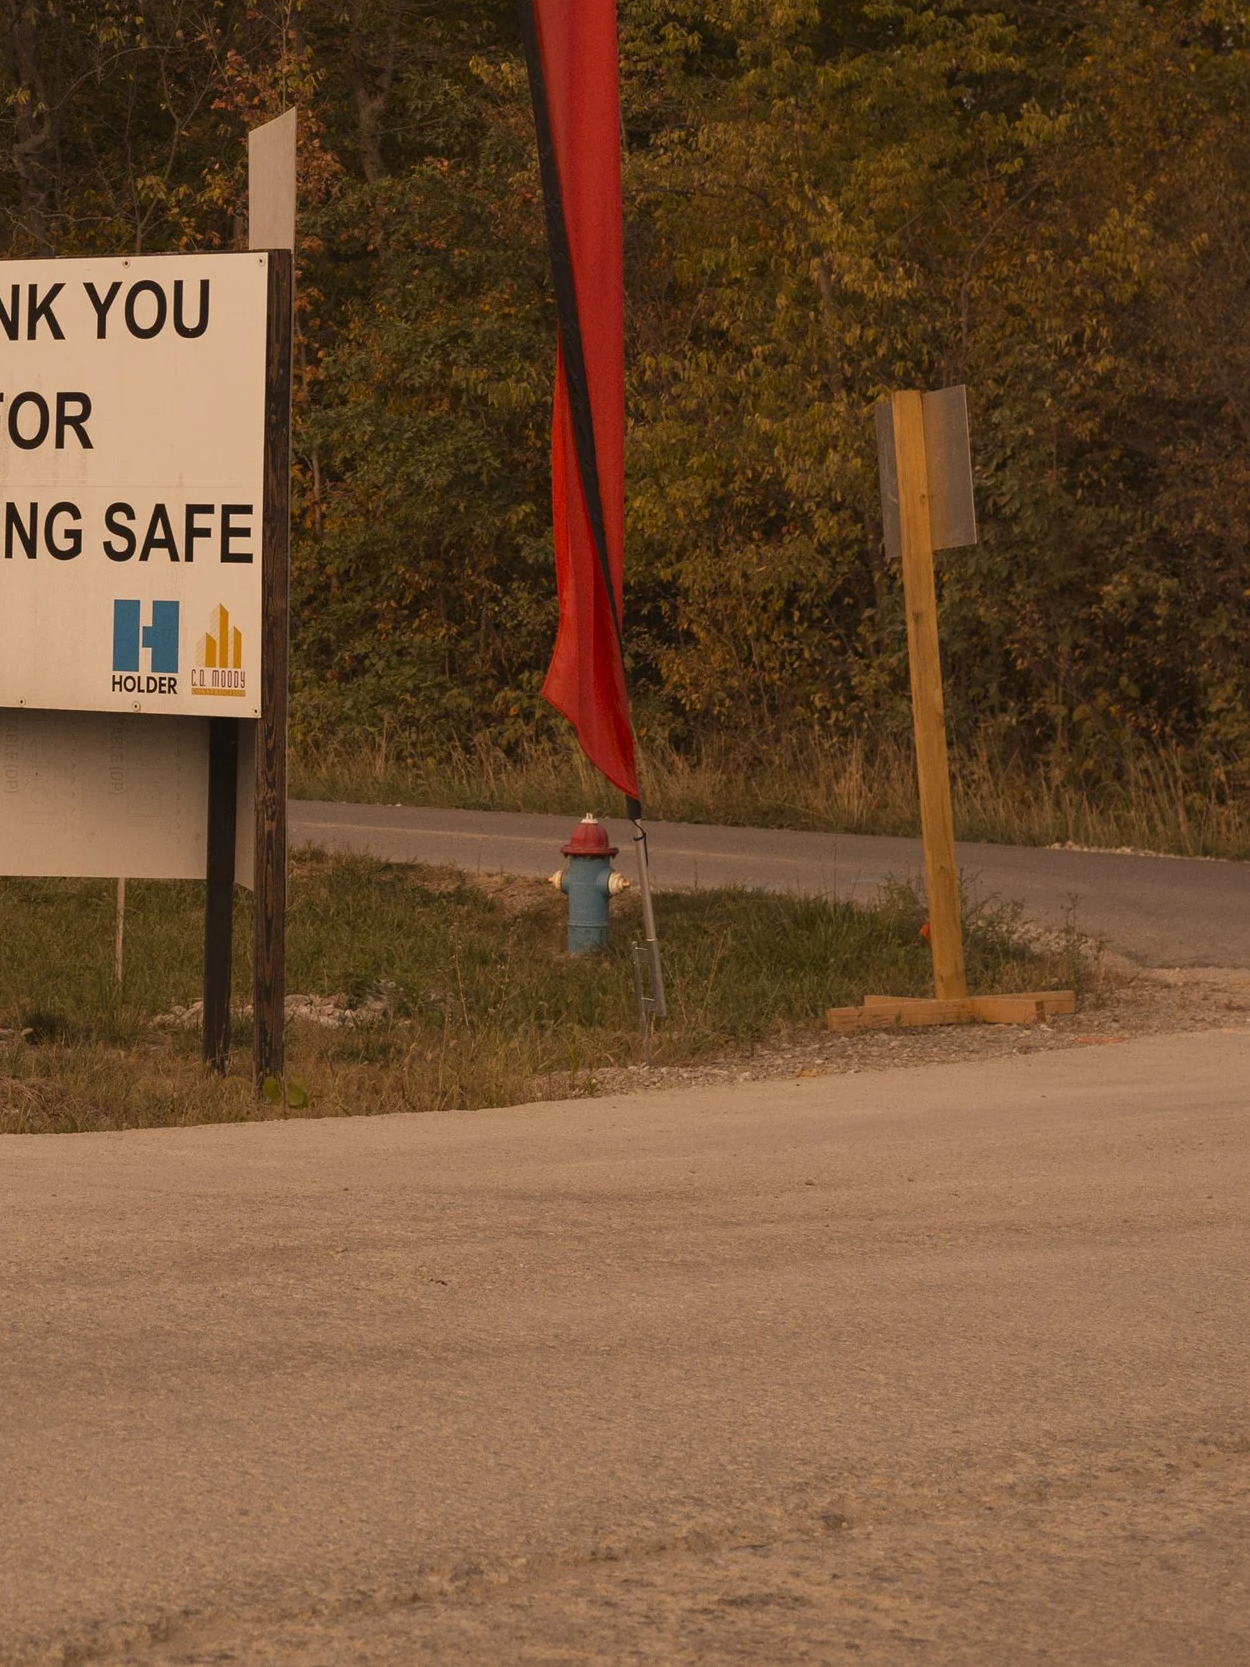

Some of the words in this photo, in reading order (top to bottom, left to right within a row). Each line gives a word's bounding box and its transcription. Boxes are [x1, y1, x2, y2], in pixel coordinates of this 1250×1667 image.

[82, 279, 211, 340] YOU
[102, 502, 254, 564] SAFE
[111, 675, 179, 695] HOLDER
[211, 670, 246, 689] MOODY
